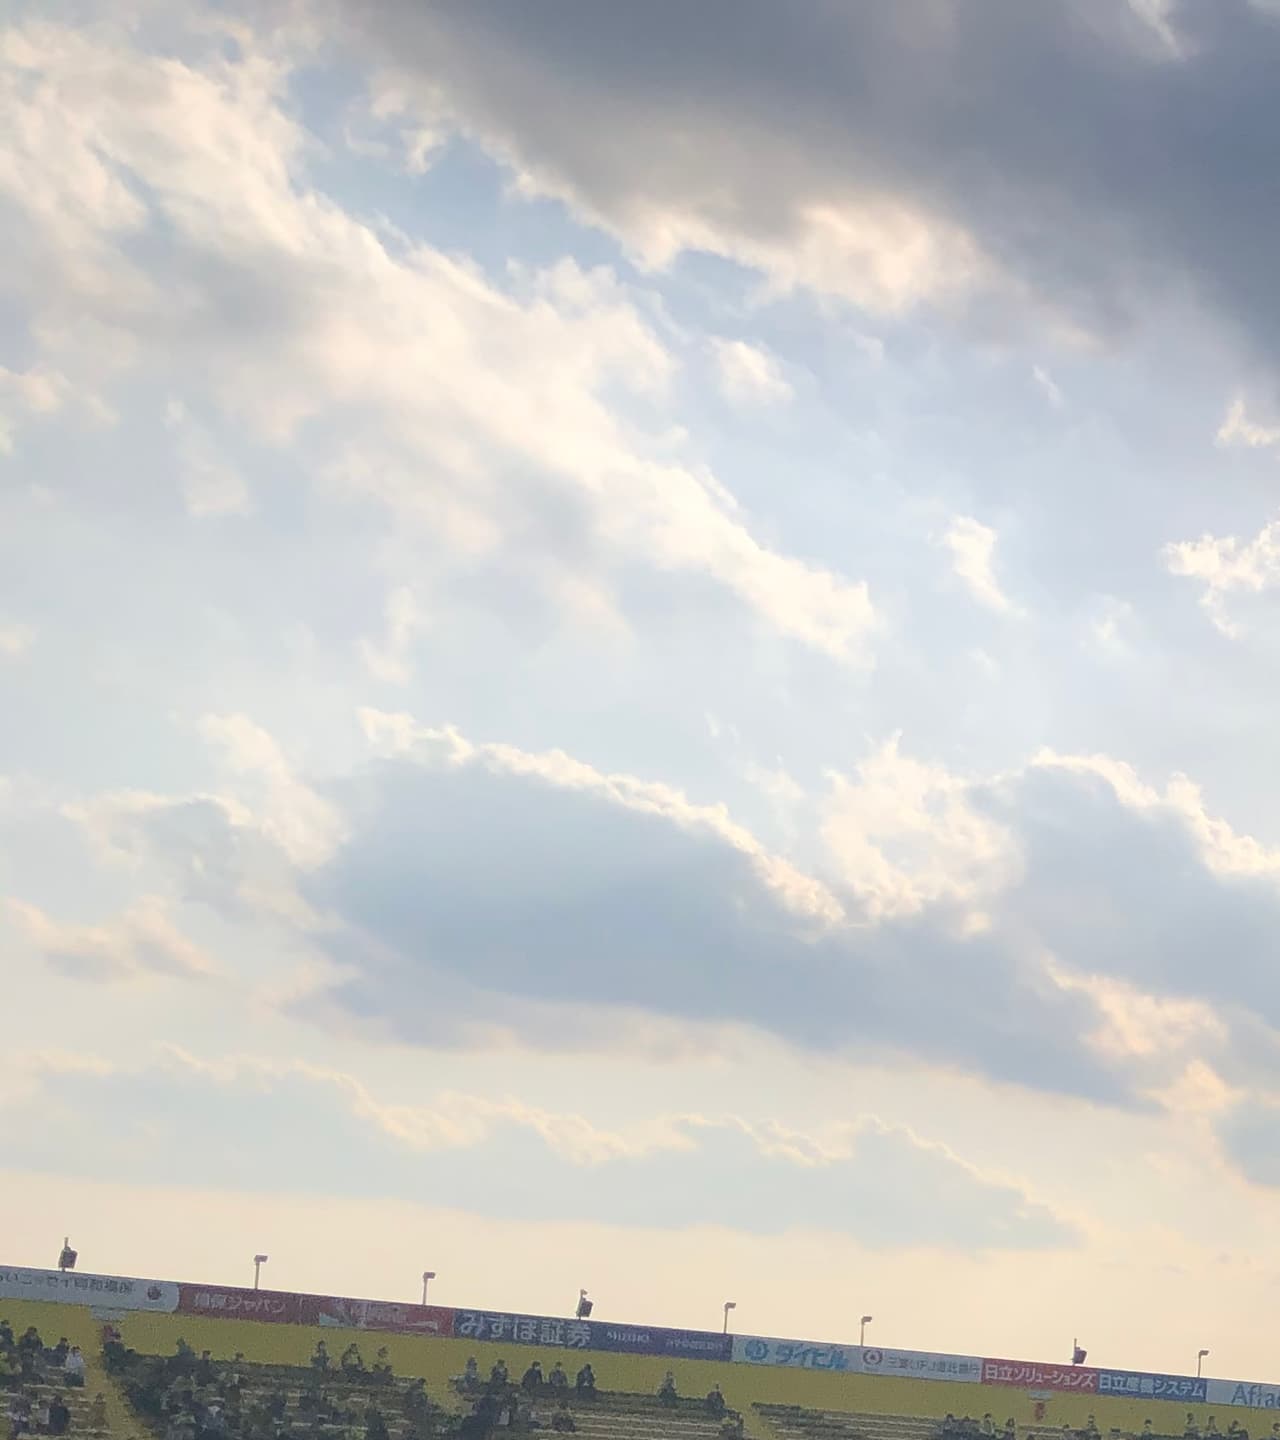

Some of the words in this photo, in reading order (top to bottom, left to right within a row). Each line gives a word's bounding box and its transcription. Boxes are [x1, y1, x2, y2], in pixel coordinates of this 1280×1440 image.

[459, 1311, 592, 1348] みずほ証券
[985, 1363, 1097, 1388] 日立ソリューションズ
